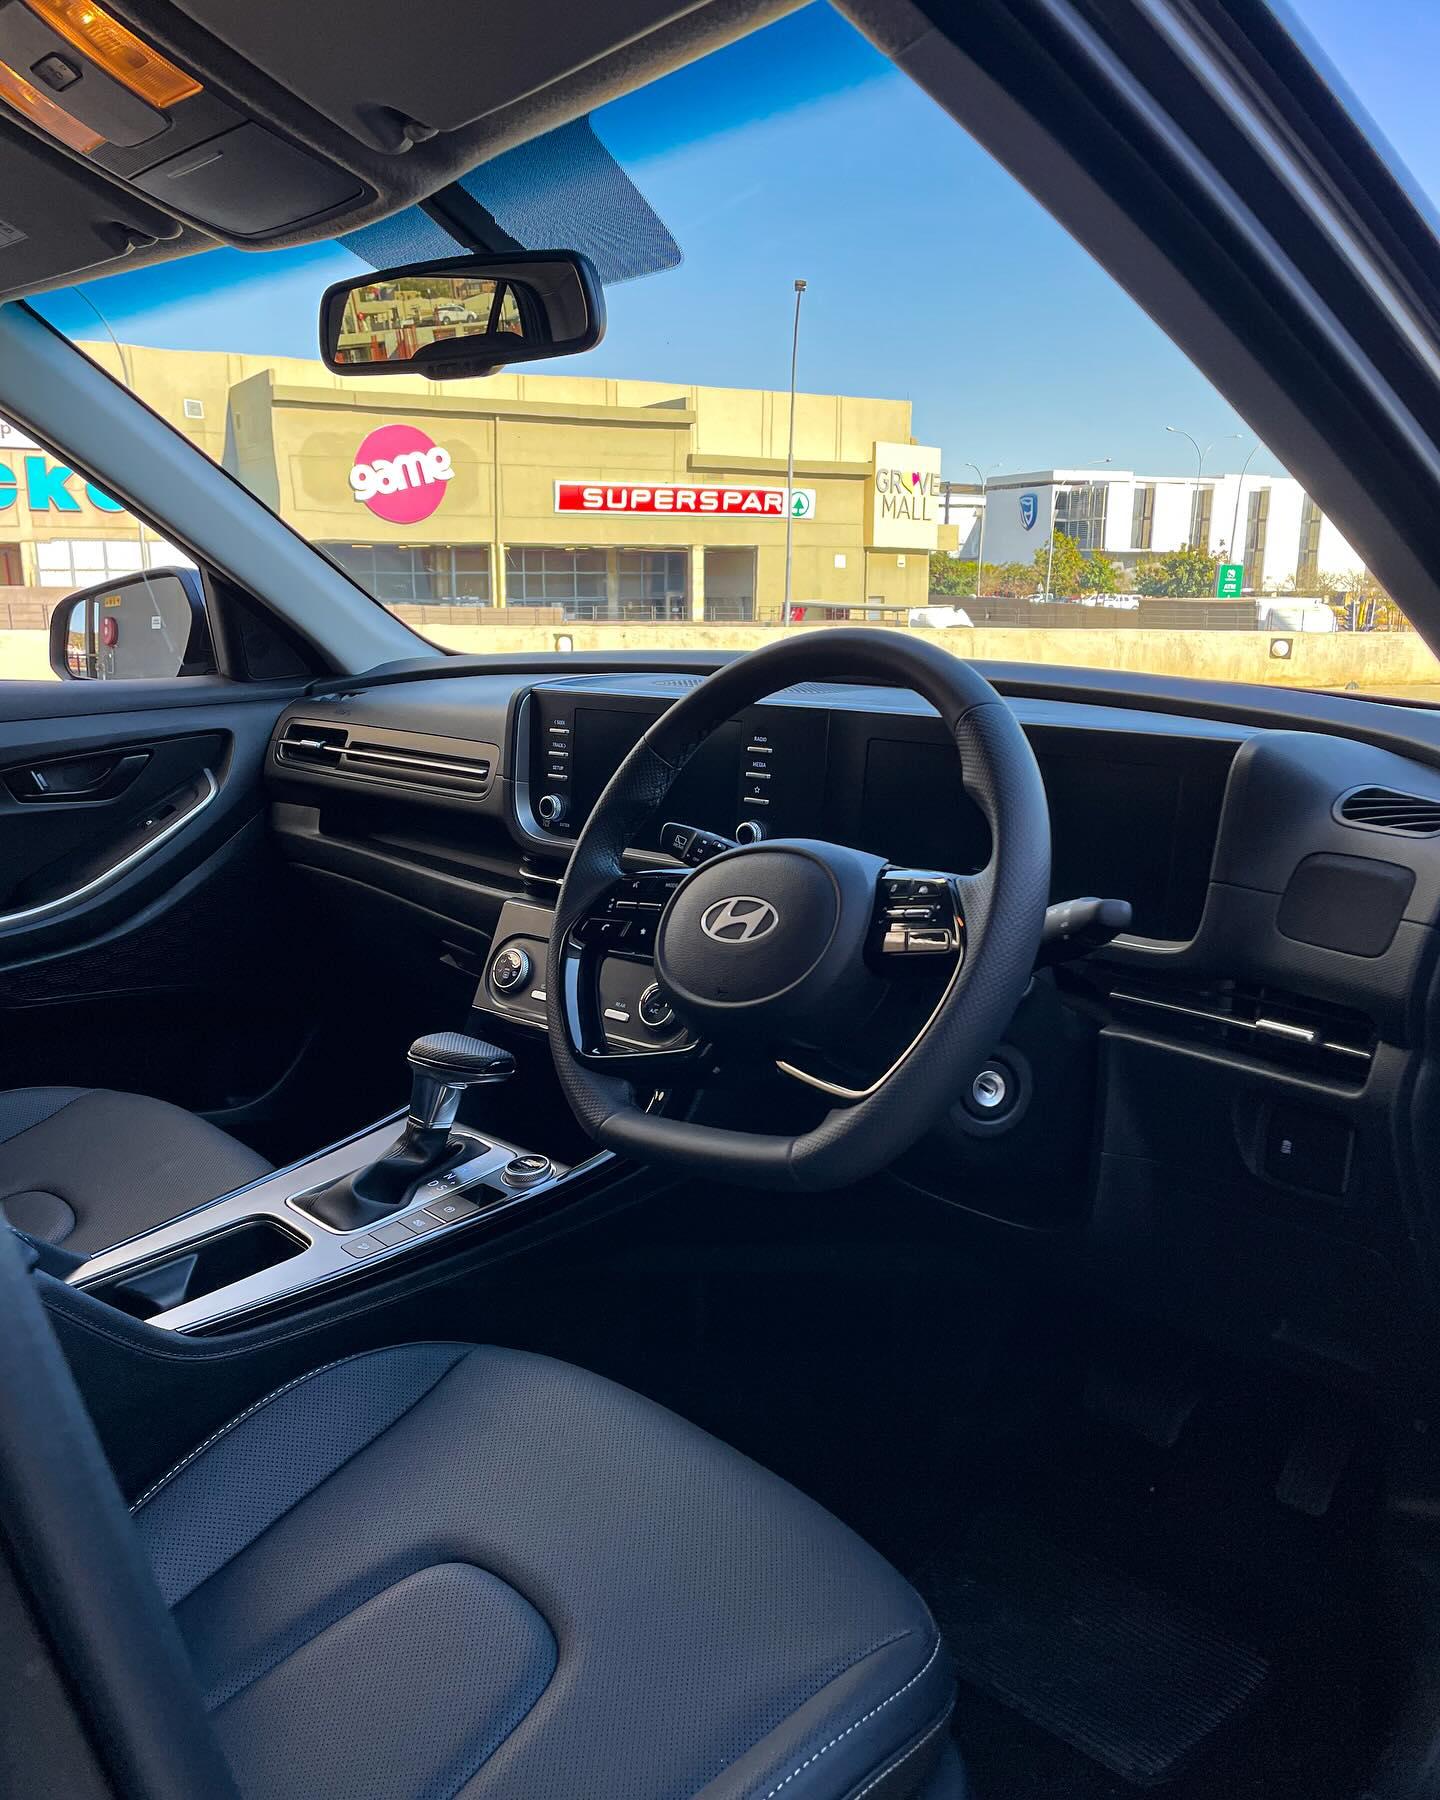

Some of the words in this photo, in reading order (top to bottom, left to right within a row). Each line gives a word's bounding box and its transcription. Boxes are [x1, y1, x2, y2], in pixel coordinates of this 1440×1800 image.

[349, 446, 455, 501] game
[582, 487, 782, 512] SUPERSPAR
[882, 495, 932, 521] MALL
